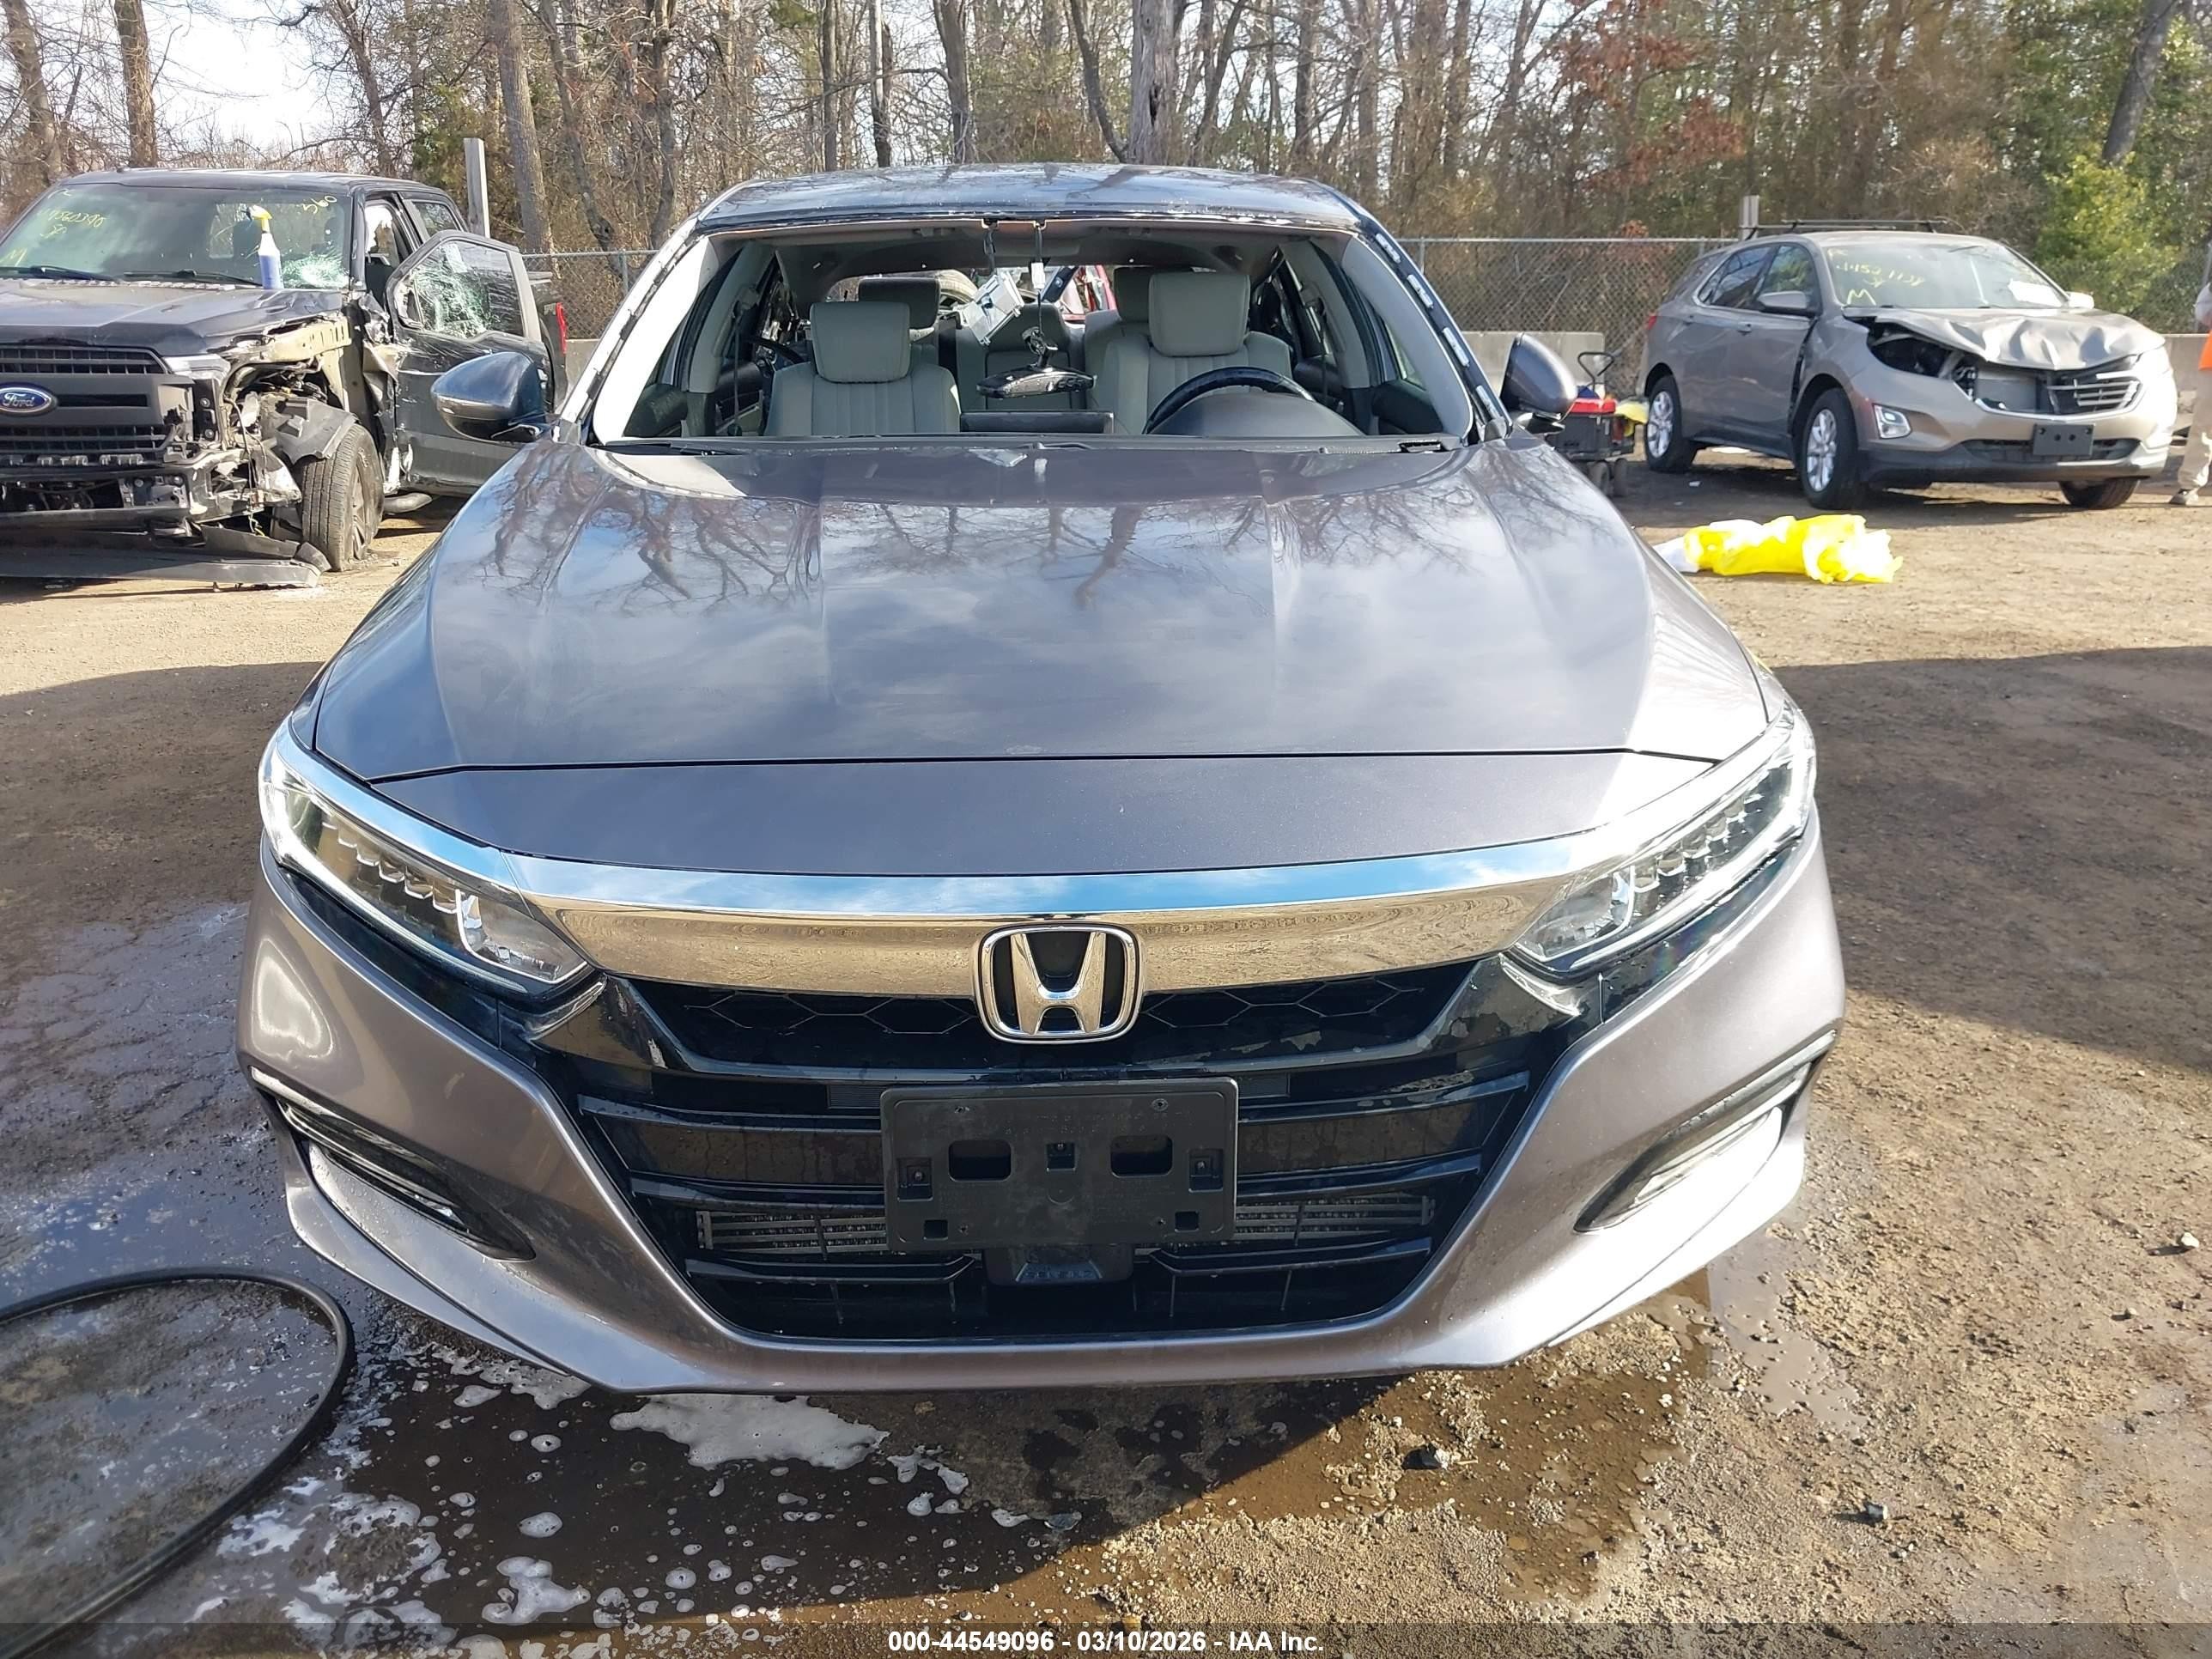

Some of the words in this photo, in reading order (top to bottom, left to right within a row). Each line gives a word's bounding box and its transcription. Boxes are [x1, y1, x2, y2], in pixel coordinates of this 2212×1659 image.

[302, 195, 337, 214] 560
[1846, 289, 1877, 306] M
[3, 392, 35, 407] Ford
